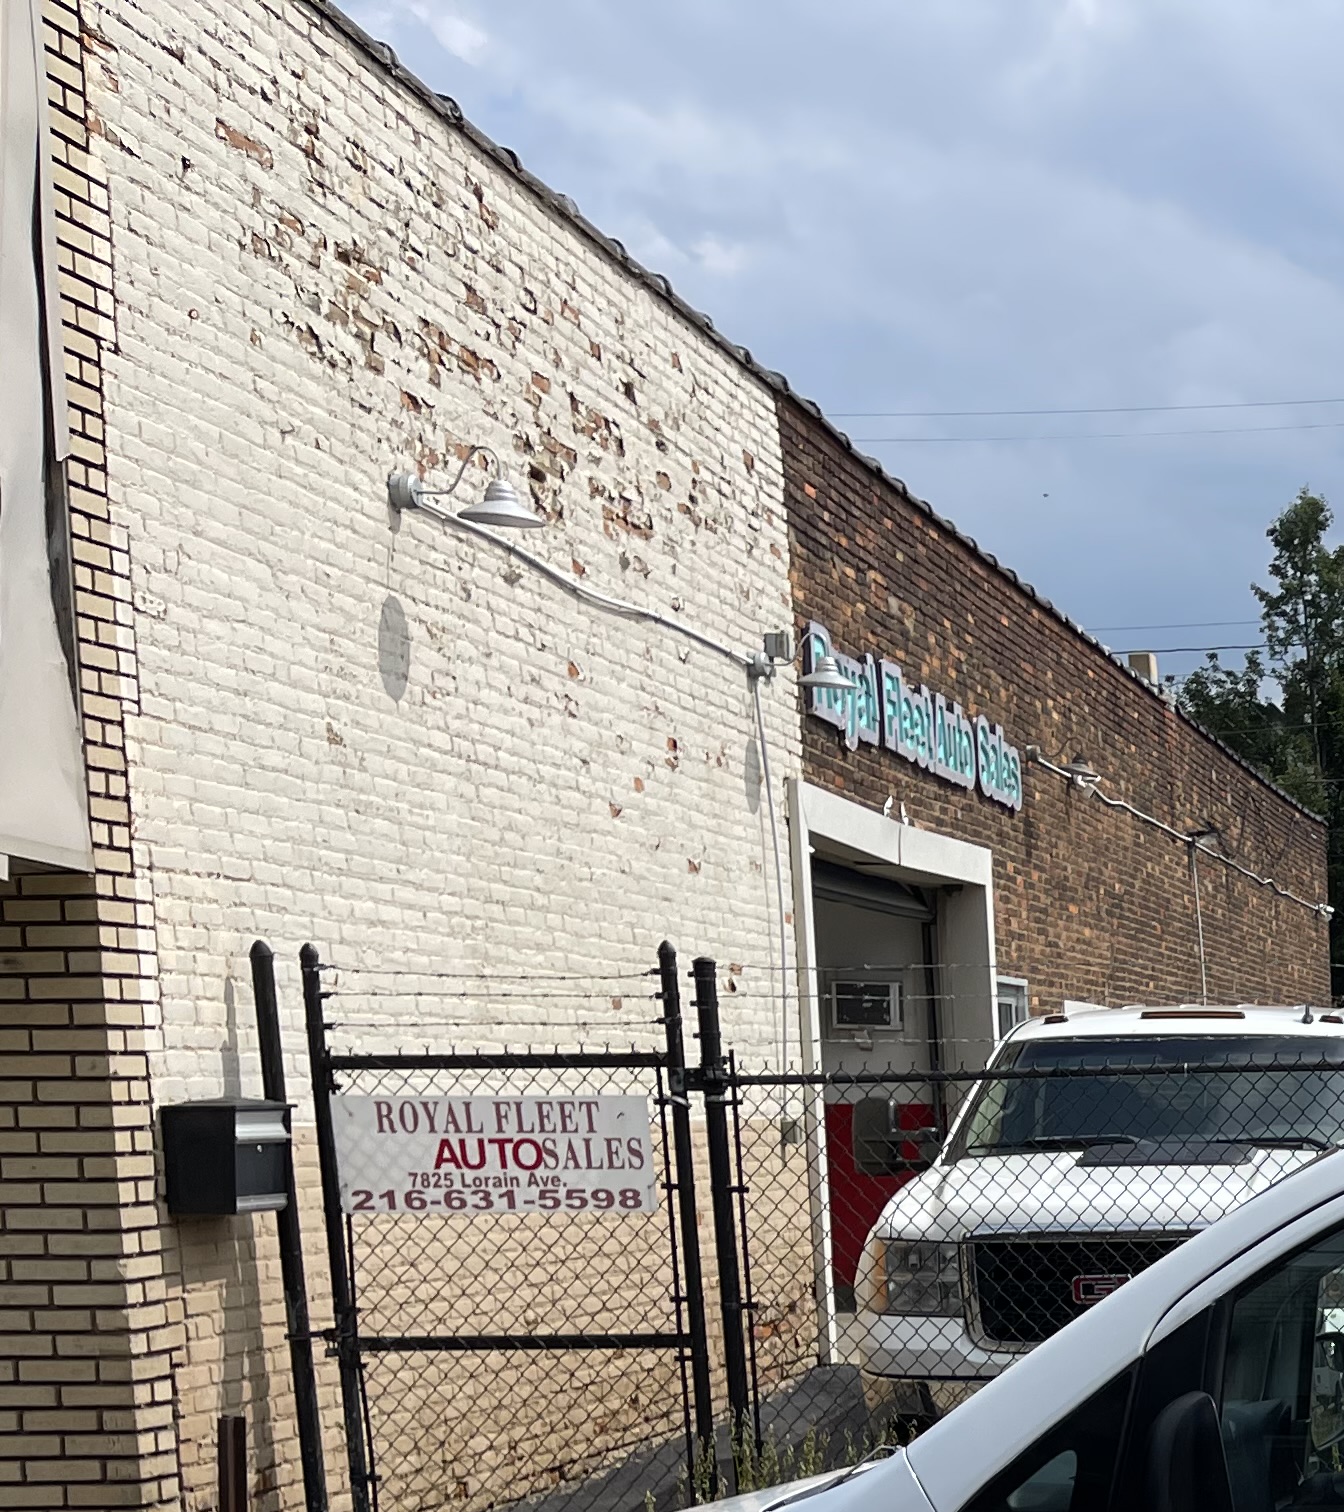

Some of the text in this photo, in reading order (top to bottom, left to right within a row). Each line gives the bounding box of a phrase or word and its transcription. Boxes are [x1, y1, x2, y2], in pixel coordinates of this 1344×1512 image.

[884, 669, 934, 762] Fleet
[937, 704, 975, 783] Auto
[978, 723, 1020, 803] Sales
[374, 1100, 600, 1134] ROYAL FLEET
[408, 1171, 568, 1189] 7825 Lorain Ave.
[351, 1189, 643, 1211] 216-631-5598
